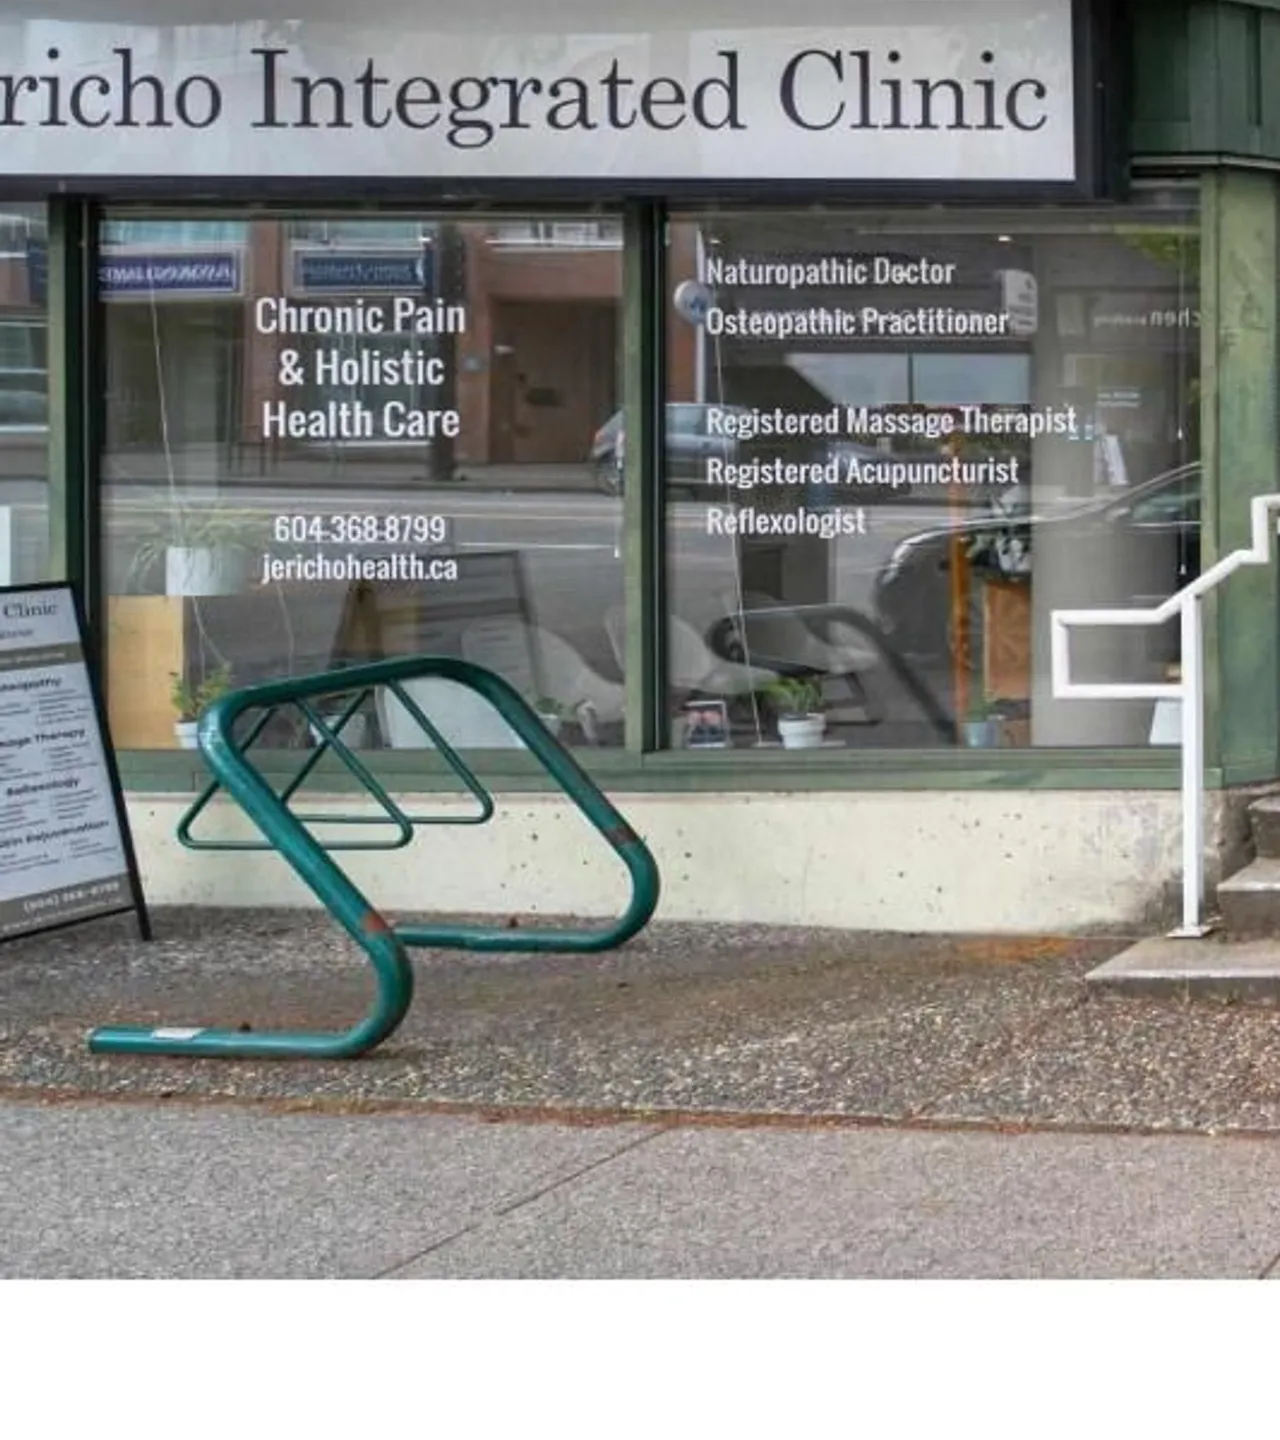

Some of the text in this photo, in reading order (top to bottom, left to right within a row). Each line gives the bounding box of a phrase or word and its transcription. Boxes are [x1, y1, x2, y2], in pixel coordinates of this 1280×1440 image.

[250, 47, 747, 148] Integrated
[779, 48, 1049, 134] Clinic
[706, 257, 956, 290] Naturopathic Doctor
[255, 297, 466, 334] Chronic Pain
[706, 307, 1010, 339] Osteopathic Practitioner
[278, 348, 445, 387] & Holistic
[262, 401, 461, 438] Health Care
[706, 406, 1077, 439] Registered Massage Therapist
[706, 457, 1019, 489] Registered Acupuncturist
[274, 515, 447, 542] 604-368-8799
[706, 506, 867, 538] Reflexologist
[260, 552, 459, 584] jerichohealth.ca
